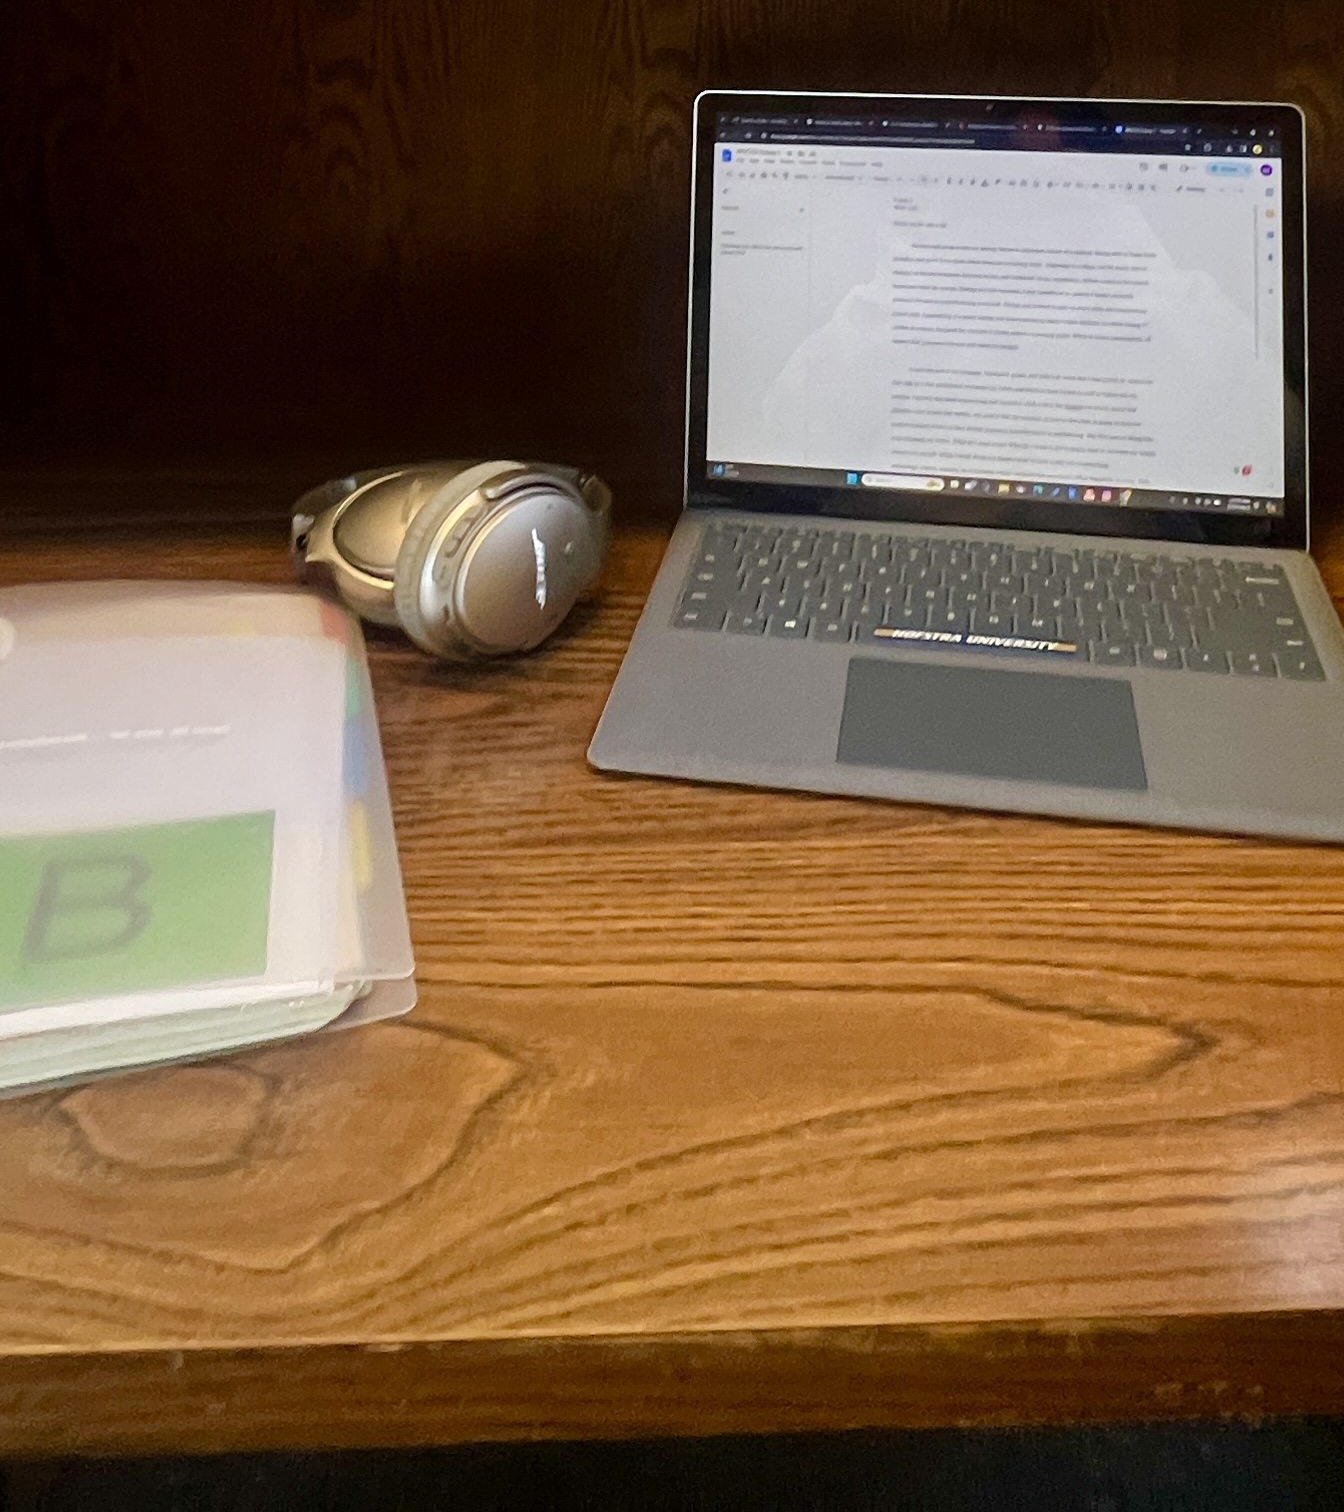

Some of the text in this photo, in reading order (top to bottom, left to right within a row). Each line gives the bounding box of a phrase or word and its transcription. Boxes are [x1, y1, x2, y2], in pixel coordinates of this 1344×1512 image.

[892, 629, 1058, 651] HOFSTRA UNIVERSITY
[22, 853, 152, 966] B
